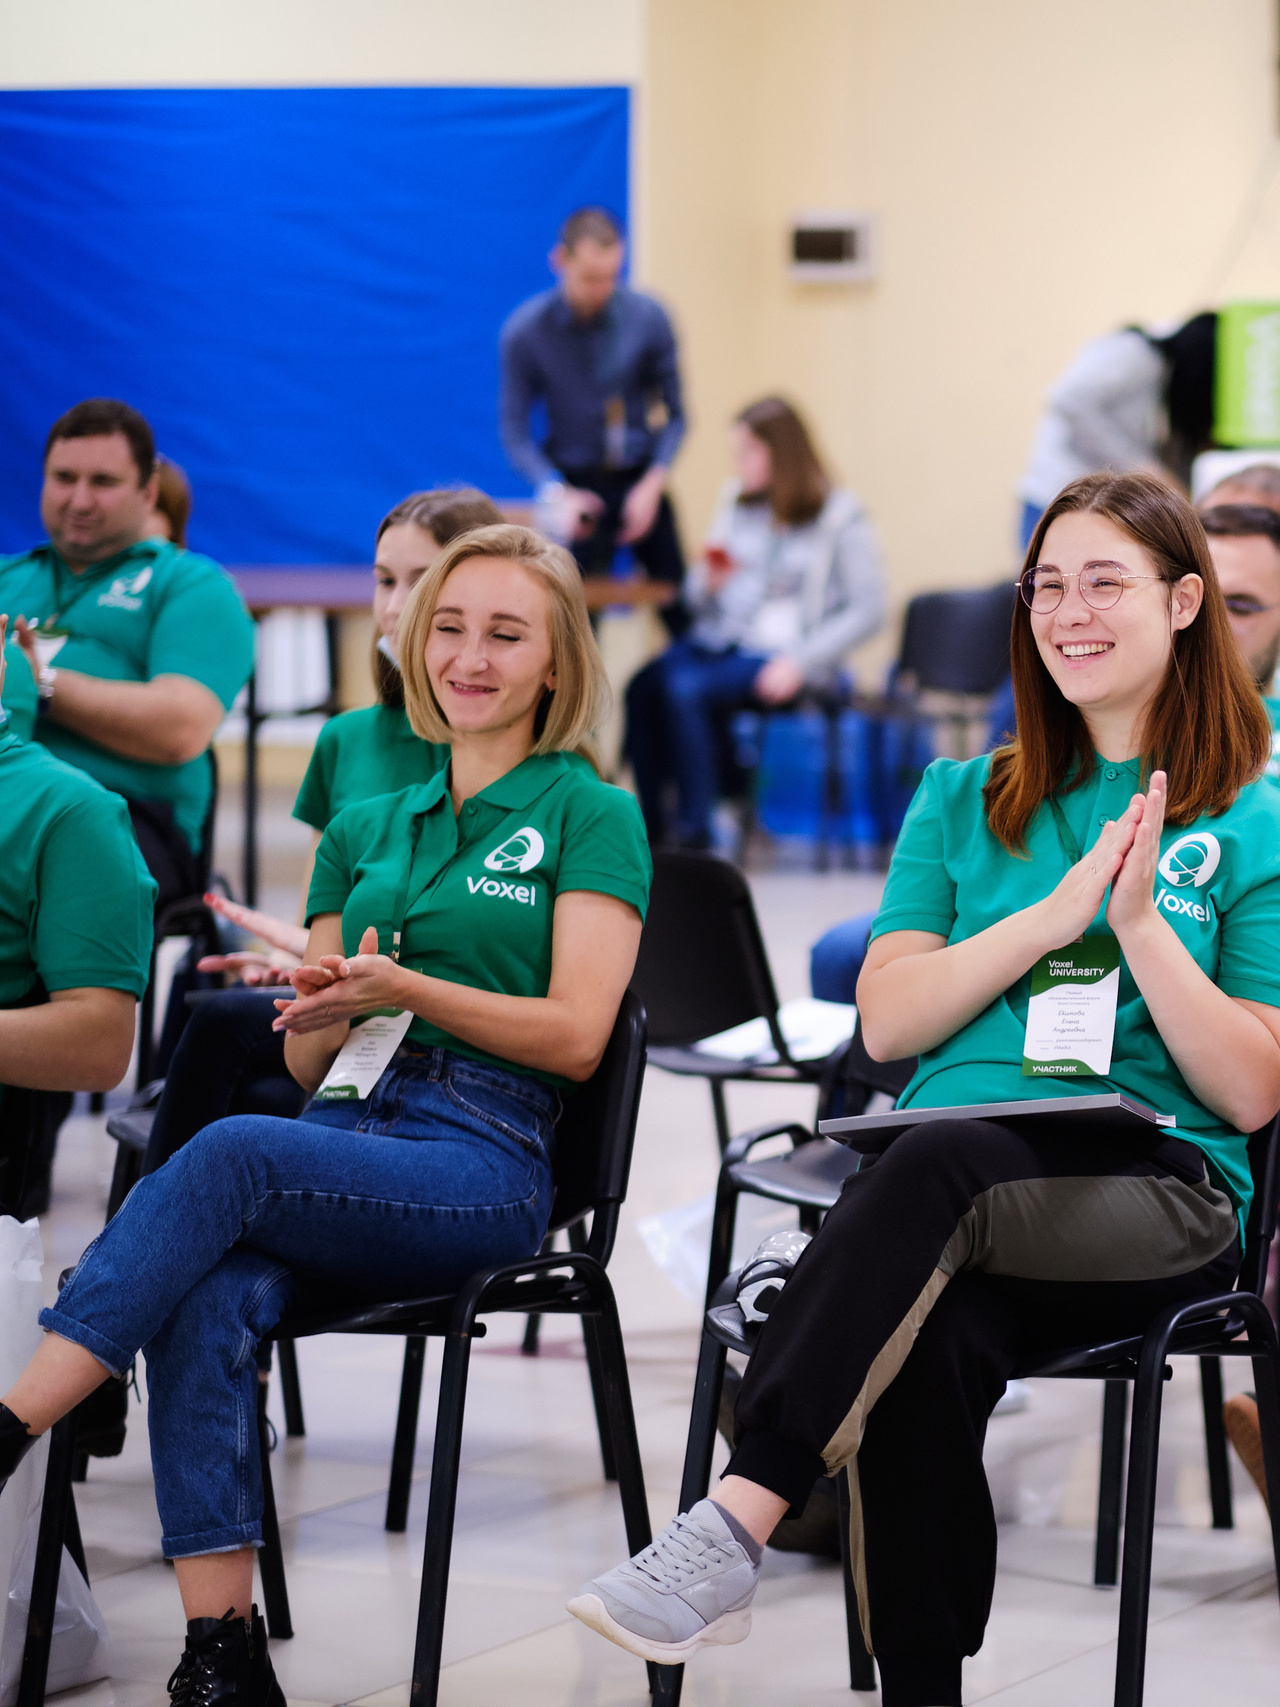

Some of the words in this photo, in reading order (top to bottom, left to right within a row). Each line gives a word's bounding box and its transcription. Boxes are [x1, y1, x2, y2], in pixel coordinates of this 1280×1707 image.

[467, 876, 536, 906] Voxel
[1048, 960, 1073, 968] Voxel
[1049, 968, 1104, 977] UNIVERSITY
[1032, 1065, 1078, 1073] УЧАСТНИК
